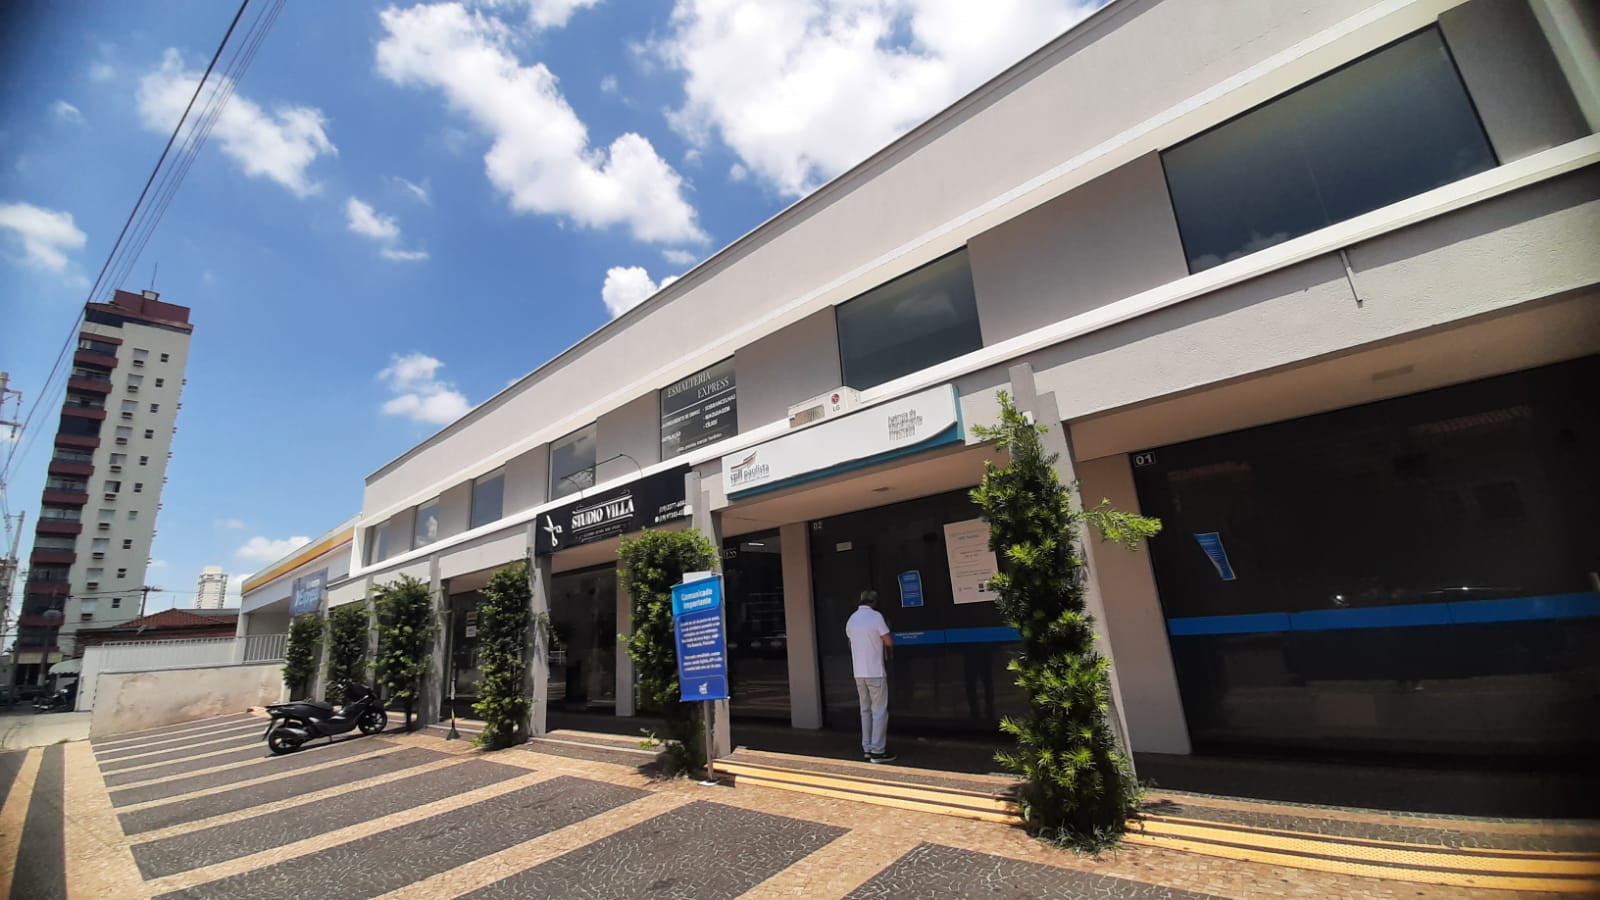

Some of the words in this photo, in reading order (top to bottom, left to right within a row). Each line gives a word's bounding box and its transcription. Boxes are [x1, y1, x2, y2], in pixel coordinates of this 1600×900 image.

[667, 371, 711, 398] ESMALTERIA
[697, 376, 729, 399] EXPRESS
[832, 404, 840, 412] LG
[1135, 454, 1152, 465] 01
[571, 509, 604, 529] STUDIO
[605, 499, 635, 519] VILLA
[681, 588, 712, 601] Comunicado
